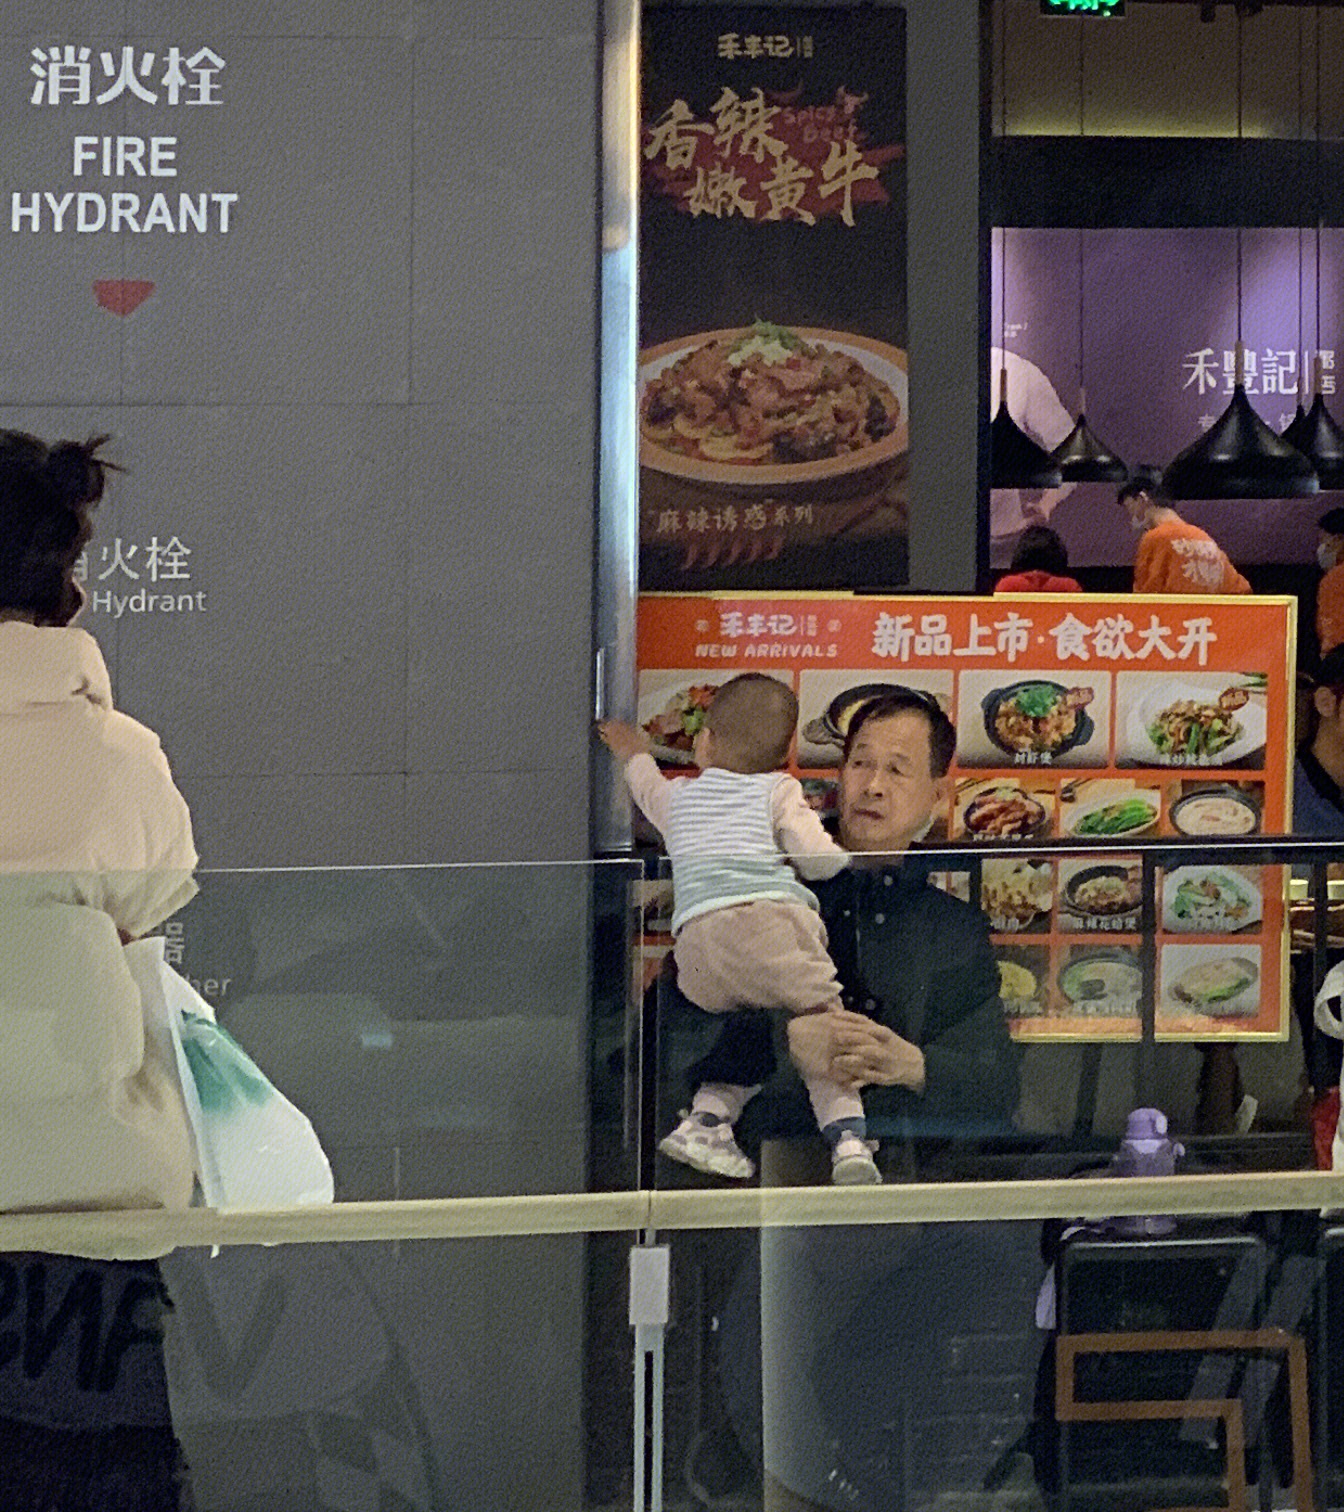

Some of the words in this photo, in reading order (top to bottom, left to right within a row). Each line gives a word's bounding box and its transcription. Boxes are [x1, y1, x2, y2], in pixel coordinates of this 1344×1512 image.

[30, 46, 226, 105] 消火栓
[645, 86, 788, 172] 香辣
[73, 137, 177, 176] FIRE
[10, 193, 238, 233] HYDRANT
[656, 501, 815, 535] 麻辣诱惑系列
[92, 589, 207, 614] Hydrant
[695, 643, 737, 657] NEW
[744, 643, 838, 658] ARRIVALS
